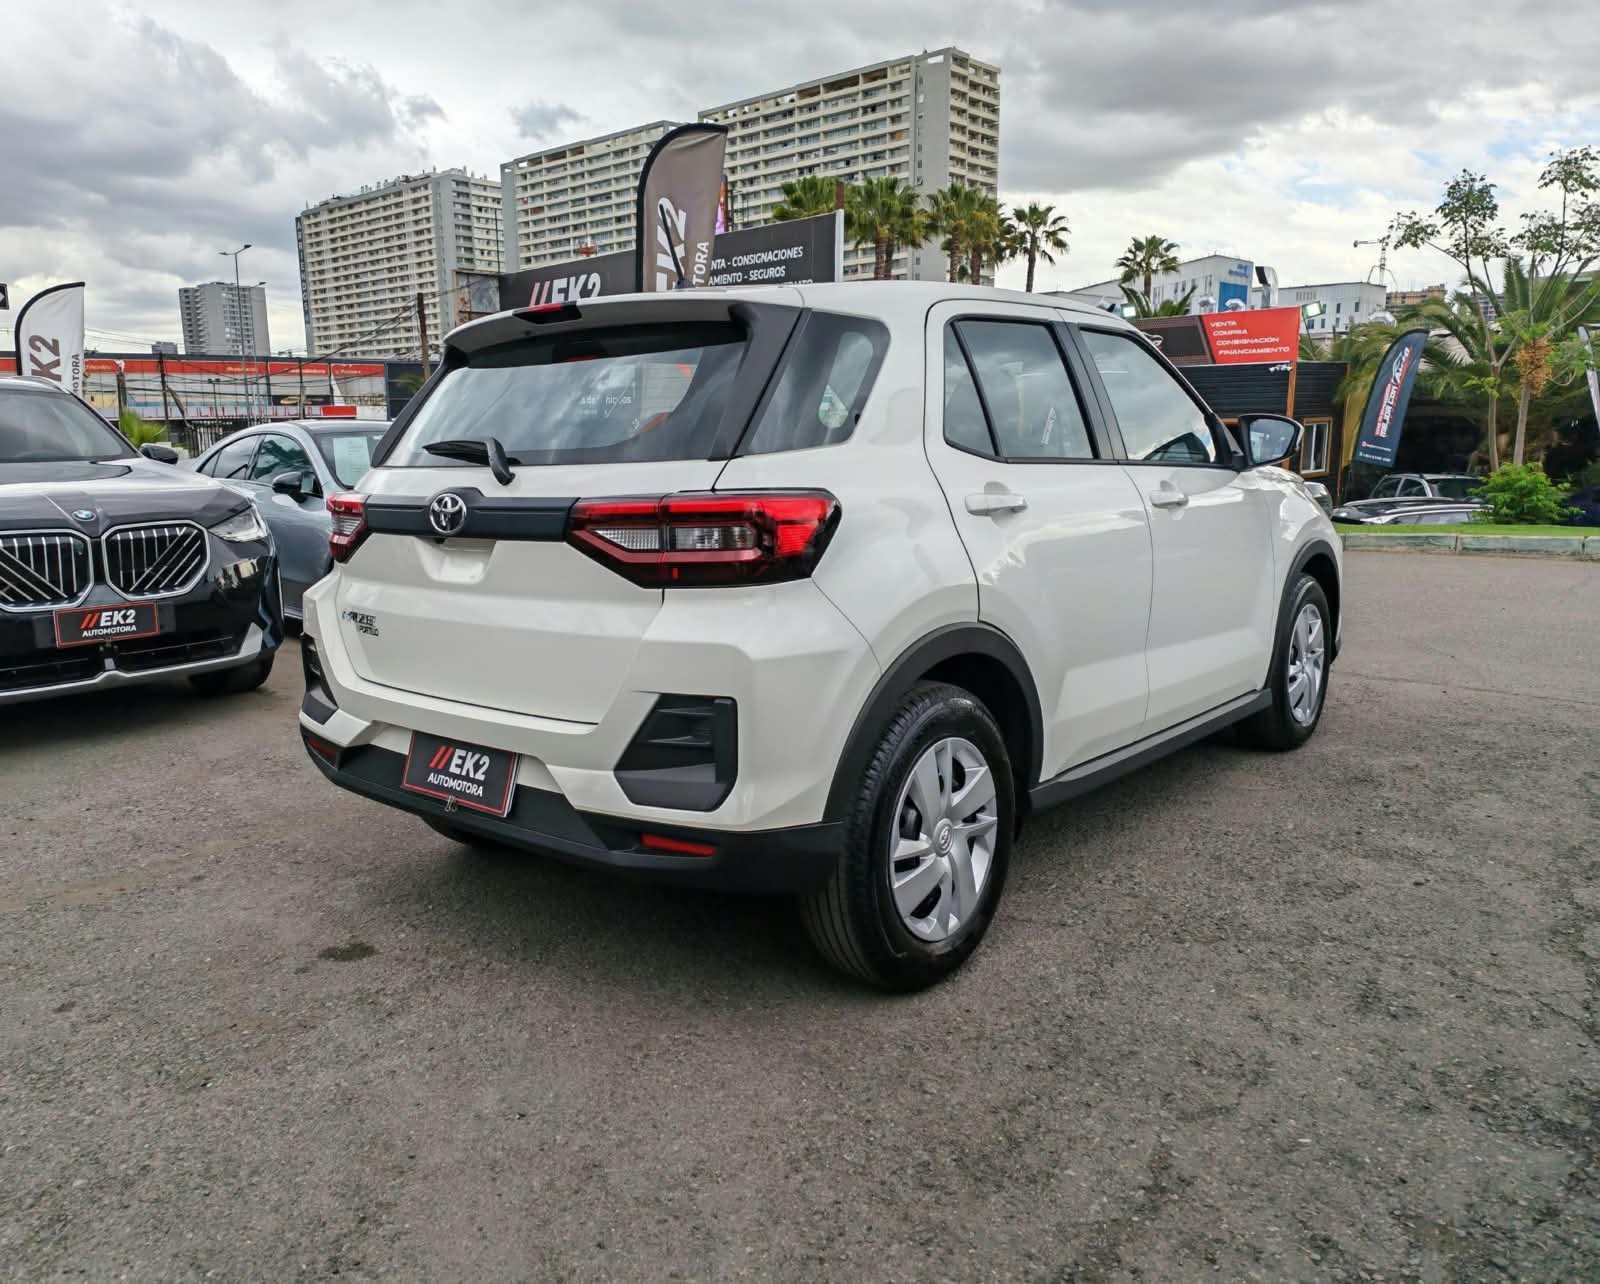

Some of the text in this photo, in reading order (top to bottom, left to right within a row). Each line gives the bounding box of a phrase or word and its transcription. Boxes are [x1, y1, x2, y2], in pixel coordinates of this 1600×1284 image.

[732, 246, 803, 267] CONSIGNACIONES
[749, 265, 785, 281] SEGUROS
[82, 624, 137, 638] AUTOMOTORA
[427, 772, 484, 798] AUTOMOTORA
